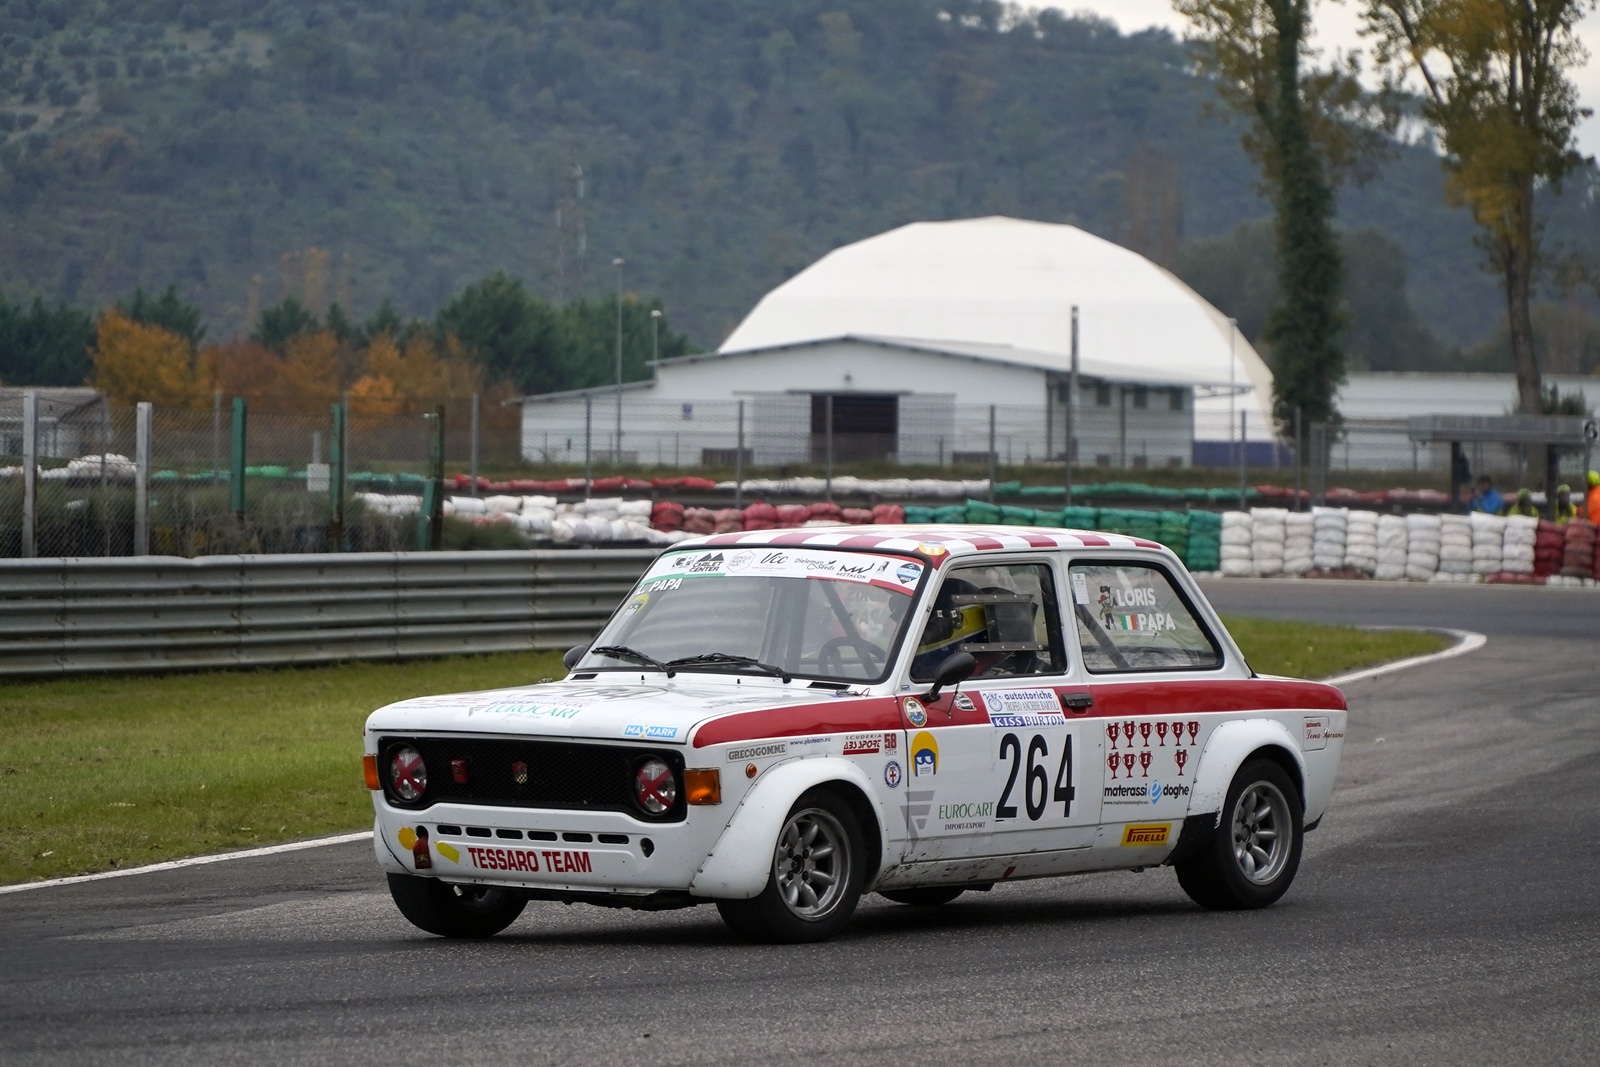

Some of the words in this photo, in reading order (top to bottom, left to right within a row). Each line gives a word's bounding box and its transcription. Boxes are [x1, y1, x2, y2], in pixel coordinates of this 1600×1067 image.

[836, 571, 867, 579] METALON
[636, 584, 646, 595] L.
[648, 578, 683, 593] PAPA
[1116, 587, 1156, 607] LORIS
[1137, 612, 1176, 631] PAPA
[1004, 690, 1053, 700] autostoriche
[995, 716, 1023, 727] KISS
[1024, 715, 1065, 726] BURTON
[626, 725, 676, 737] MAXMARK
[858, 740, 881, 749] SPORT
[884, 733, 897, 749] 58
[728, 744, 786, 760] GRECOGOMME
[995, 732, 1075, 821] 264
[1104, 783, 1148, 797] materassi
[1163, 783, 1190, 799] doghe
[938, 801, 994, 819] EUROCART
[944, 821, 986, 831] IMPORT-EXPORT
[1126, 827, 1167, 843] PIRELLI
[467, 847, 539, 873] TESSARO
[542, 850, 593, 873] TEAM
